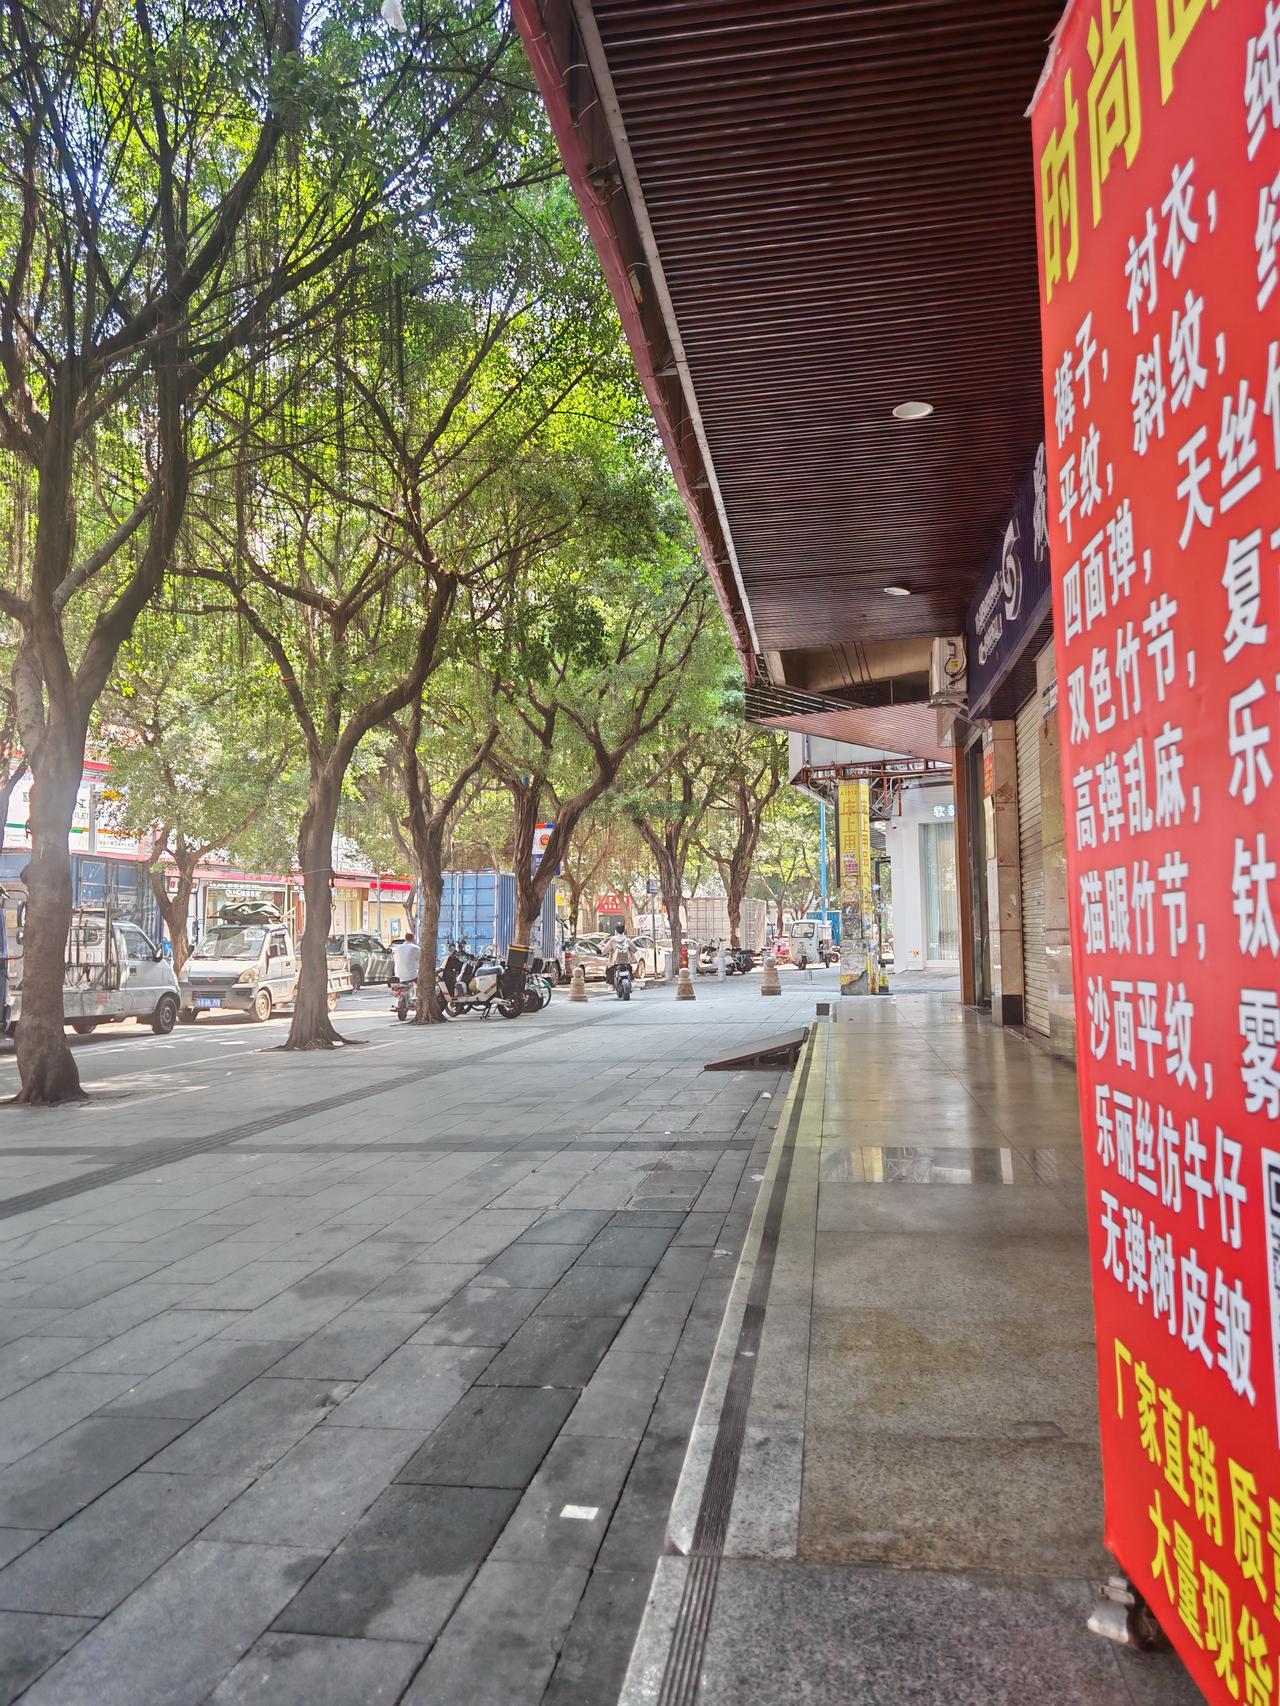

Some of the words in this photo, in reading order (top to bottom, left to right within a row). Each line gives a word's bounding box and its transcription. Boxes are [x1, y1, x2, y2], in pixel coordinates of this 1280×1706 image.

[1096, 1083, 1247, 1251] 乐丽丝仿牛仔
[1100, 1189, 1256, 1407] 无弹树皮皱
